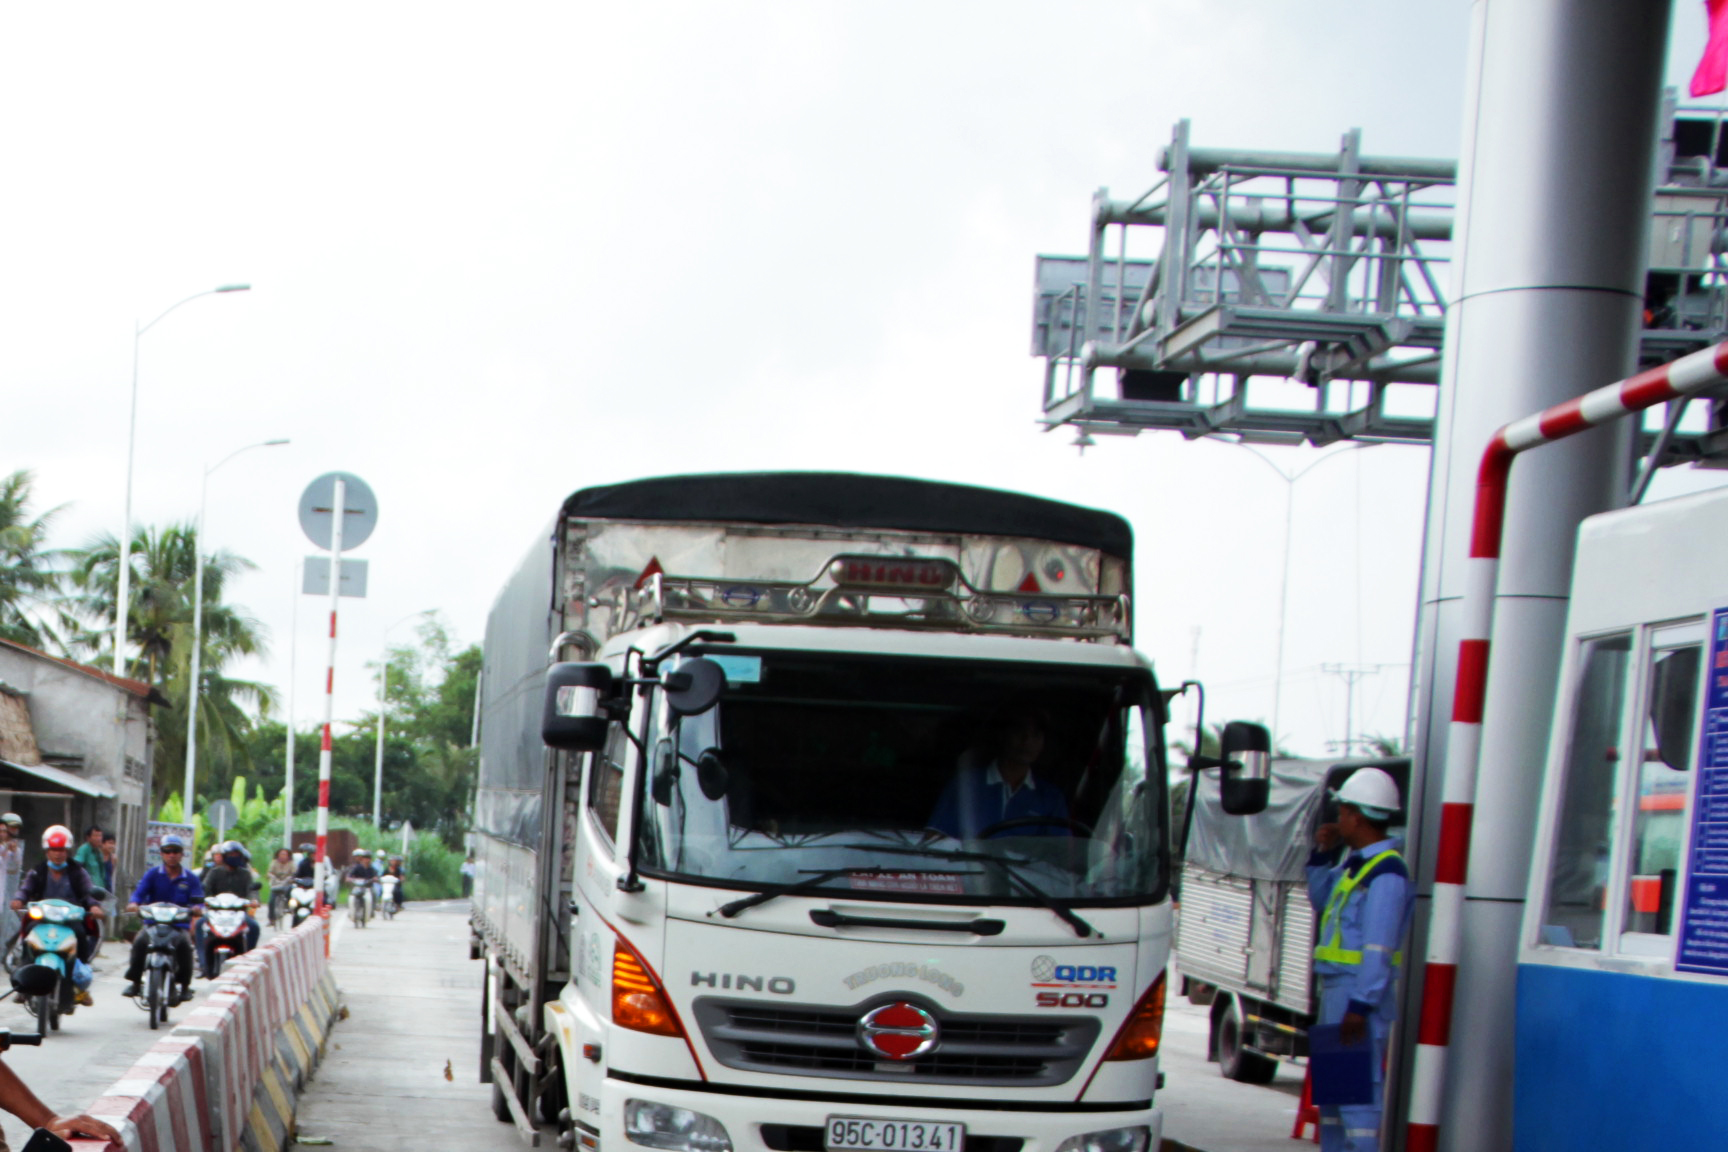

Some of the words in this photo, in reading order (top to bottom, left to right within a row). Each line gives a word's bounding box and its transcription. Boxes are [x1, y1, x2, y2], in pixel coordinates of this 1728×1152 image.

[848, 563, 943, 585] HINO
[691, 971, 796, 995] HINO
[1055, 965, 1117, 982] QDR
[1035, 992, 1109, 1008] 500
[832, 1121, 956, 1150] 95C-013.41
